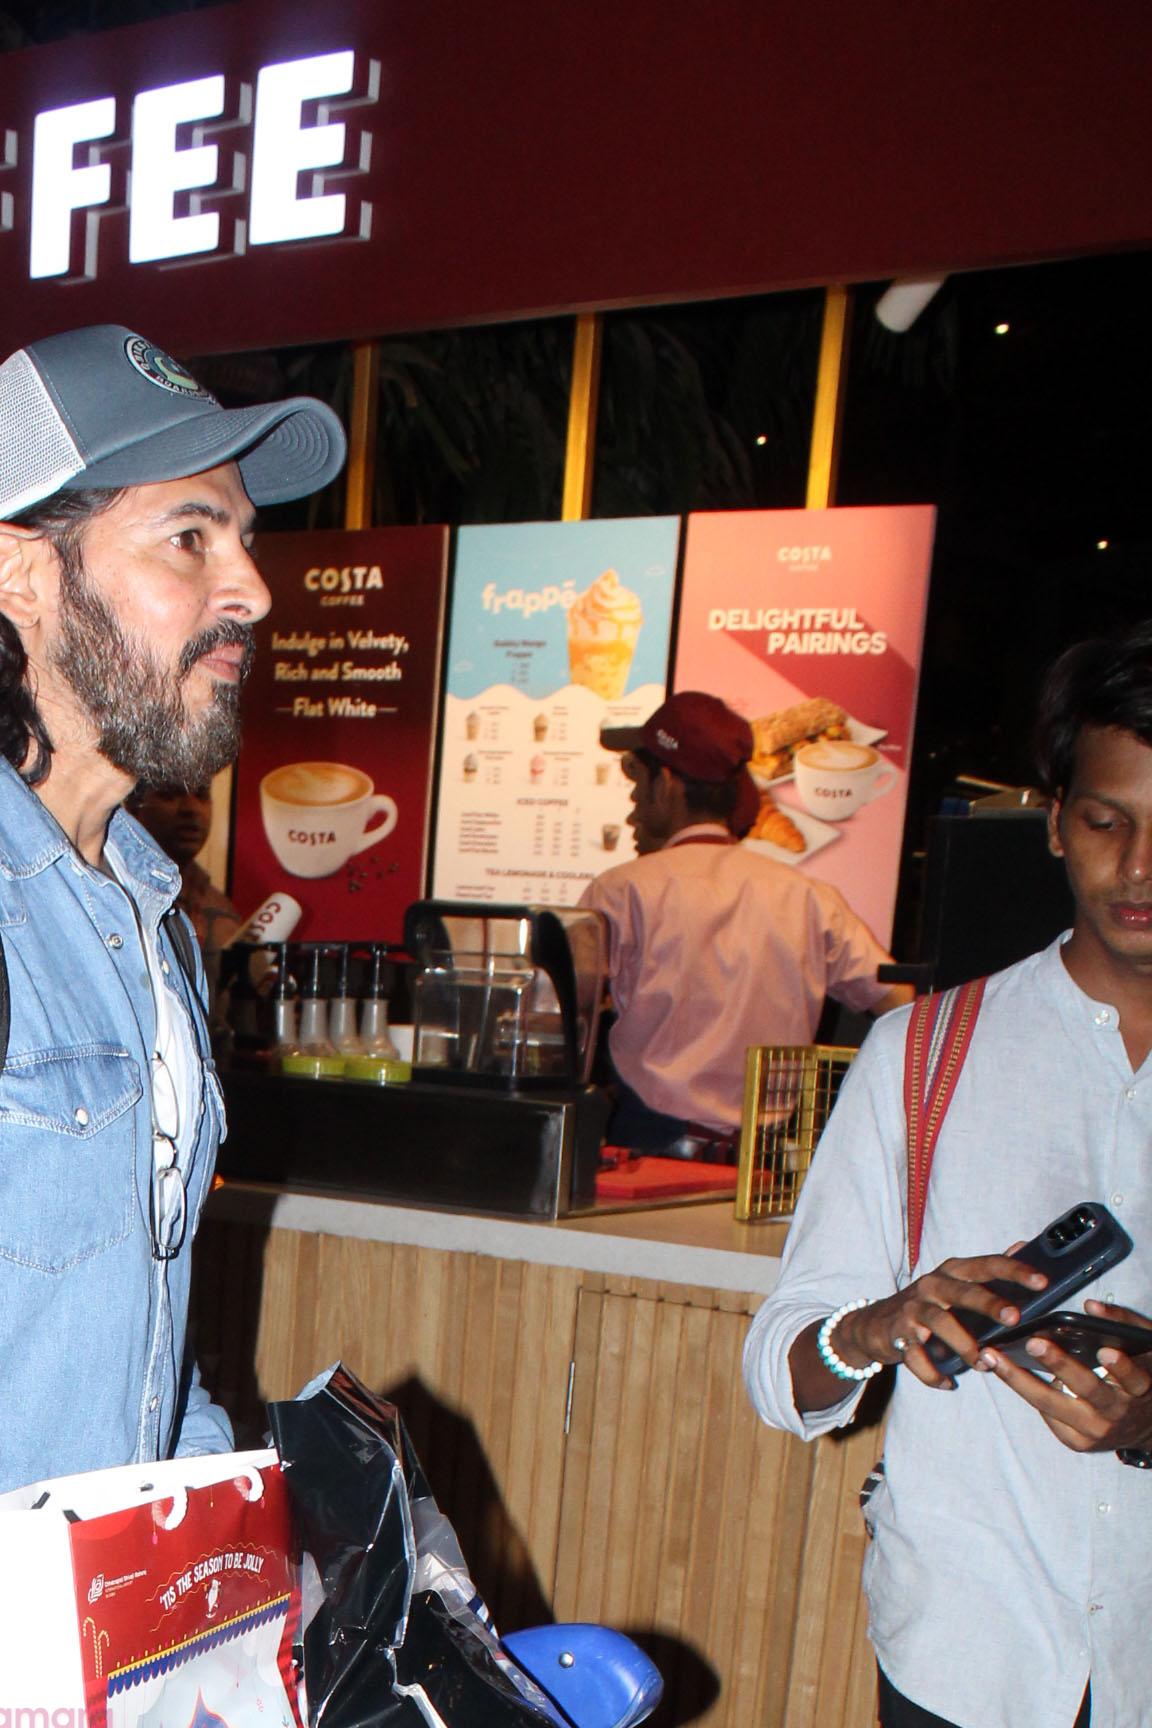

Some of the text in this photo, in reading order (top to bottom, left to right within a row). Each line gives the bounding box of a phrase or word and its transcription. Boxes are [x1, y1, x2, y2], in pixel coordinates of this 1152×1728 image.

[778, 545, 832, 563] COSTA
[304, 565, 384, 593] COSTA
[320, 594, 365, 607] COFFEE
[482, 579, 577, 618] frappé
[708, 607, 865, 632] DELIGHTFUL
[271, 629, 409, 657] Indulge in Velvety,
[767, 631, 887, 655] PAIRINGS
[274, 660, 402, 681] Rich and Smooth
[293, 697, 377, 718] Flat White
[814, 786, 853, 800] COSTA
[288, 829, 337, 846] COSTA
[159, 1585, 178, 1612] 'TIS
[176, 1574, 193, 1597] THE
[193, 1554, 224, 1583] SEASON
[224, 1553, 234, 1570] TO
[233, 1551, 244, 1570] BE
[243, 1551, 265, 1575] JOLLY
